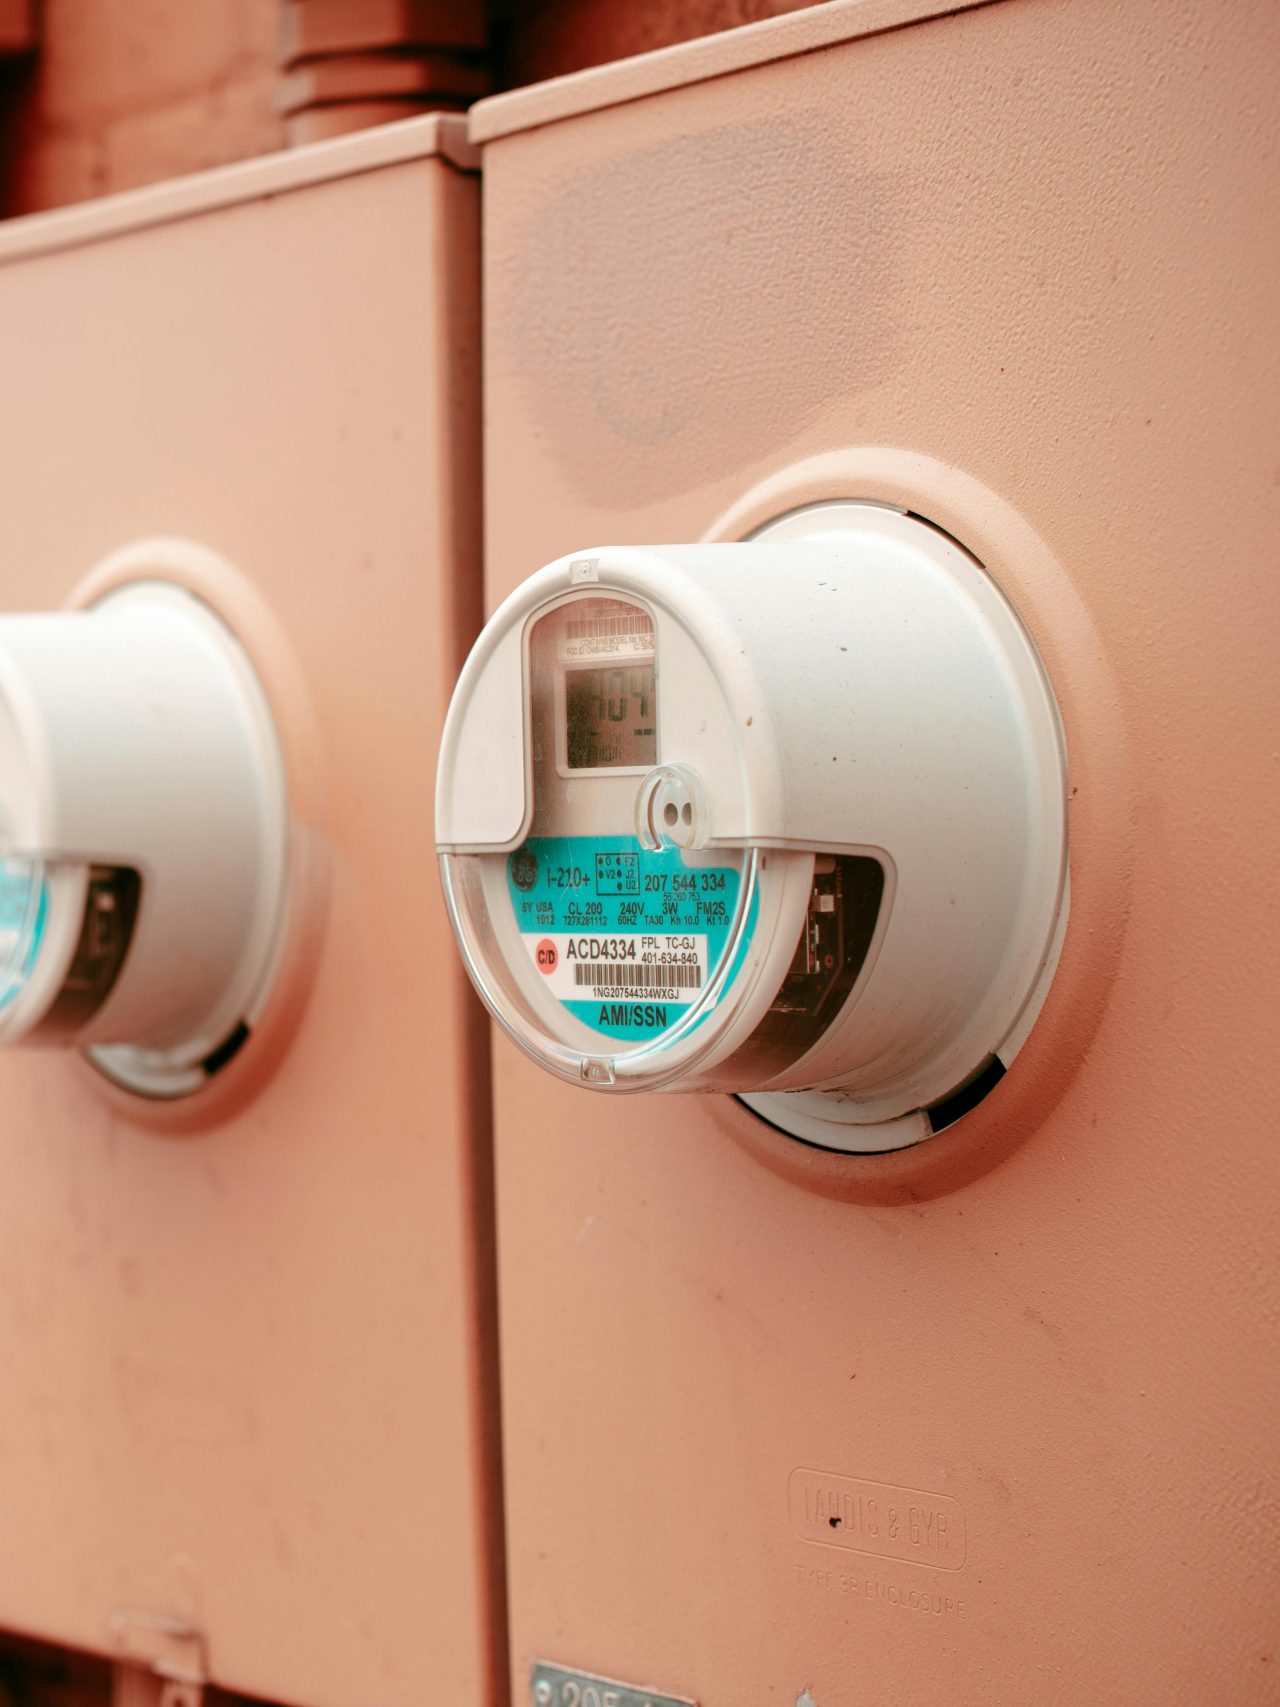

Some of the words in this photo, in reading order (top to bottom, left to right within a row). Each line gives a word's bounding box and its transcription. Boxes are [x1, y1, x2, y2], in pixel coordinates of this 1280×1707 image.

[546, 867, 591, 888] I-210+
[606, 869, 615, 879] V2
[644, 874, 668, 892] 207
[672, 873, 696, 892] 544
[701, 873, 726, 892] 334
[536, 902, 553, 913] USA
[568, 902, 582, 915] CL
[585, 902, 603, 915] 200
[620, 902, 645, 915] 240V
[662, 902, 679, 915] 3W
[696, 901, 726, 916] FM2S
[617, 915, 637, 925] 60HZ
[644, 915, 664, 925] TA30
[670, 915, 681, 925] Kh
[683, 915, 700, 926] 10.0
[718, 915, 730, 926] 1.0
[566, 938, 637, 960] ACD4334
[641, 936, 660, 949] FPL
[665, 936, 696, 950] TC-GJ
[537, 949, 556, 965] C/D
[641, 952, 698, 965] 401-634-840
[592, 986, 680, 1000] 1NG207544334WXGJ
[598, 1004, 667, 1028] AMI/SSN
[888, 1507, 901, 1540] &
[908, 1506, 949, 1550] GYR
